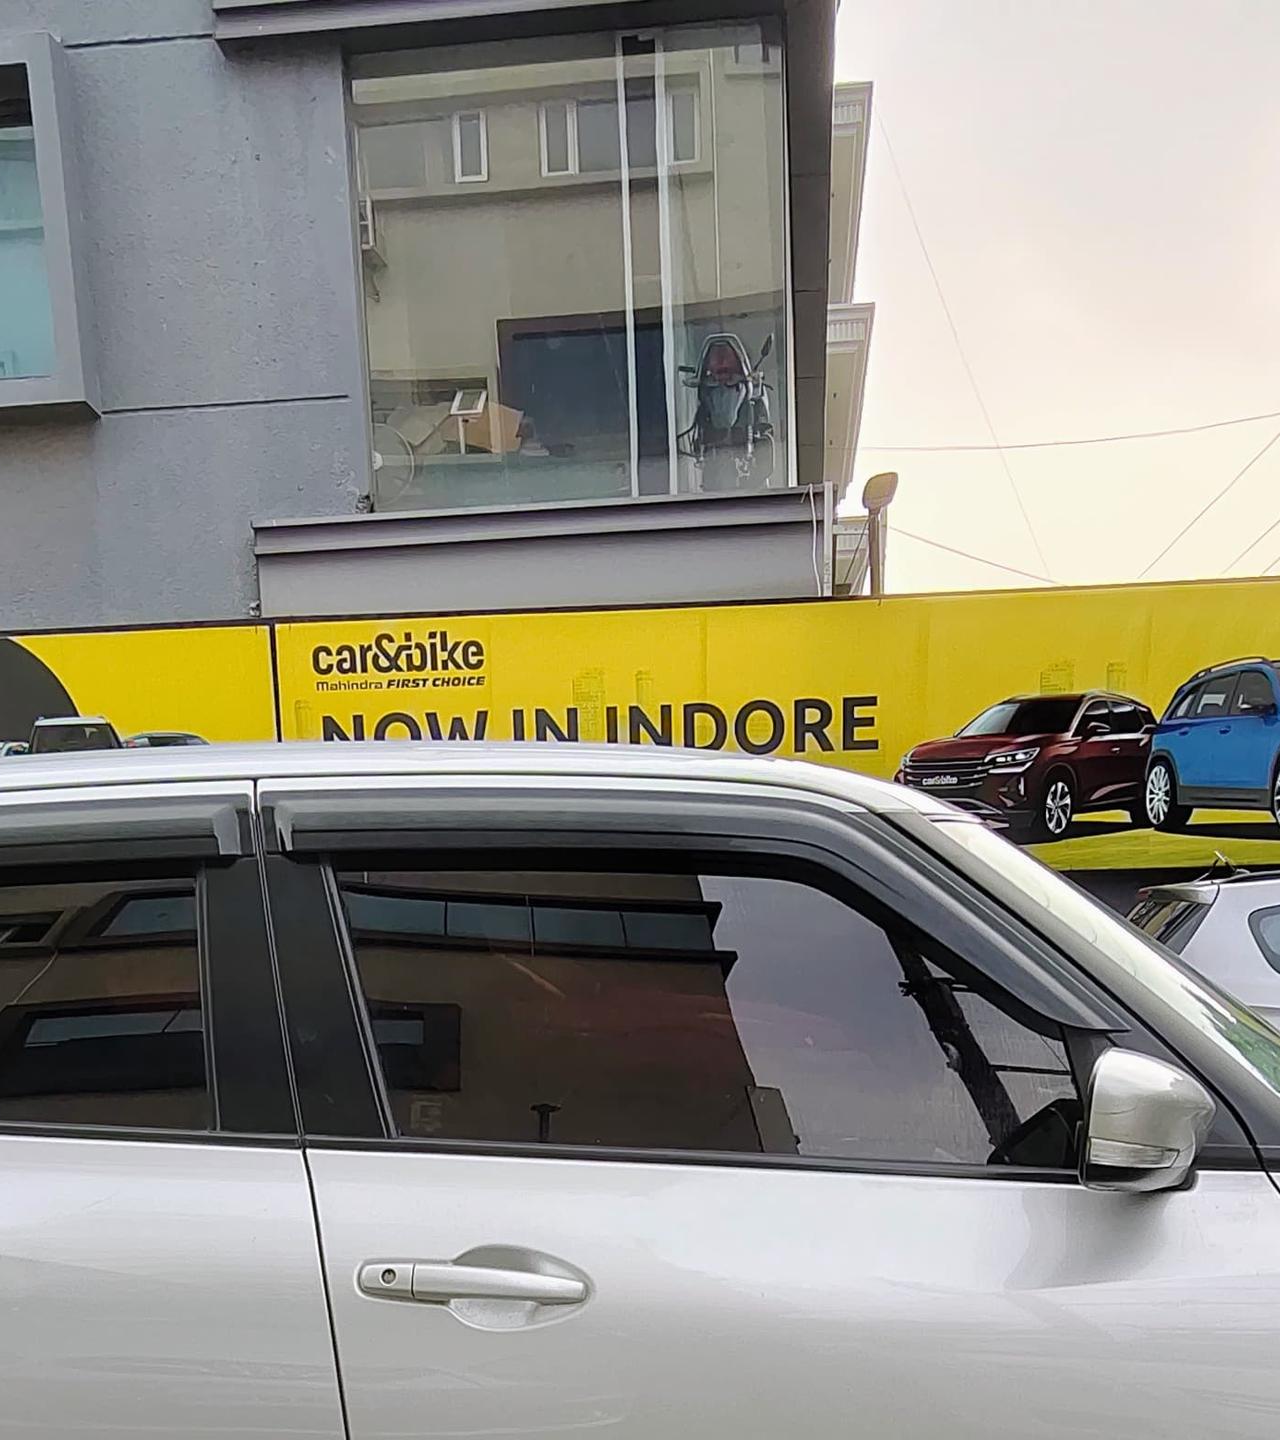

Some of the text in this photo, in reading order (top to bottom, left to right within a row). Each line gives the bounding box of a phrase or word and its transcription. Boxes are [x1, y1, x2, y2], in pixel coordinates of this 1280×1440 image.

[312, 631, 484, 675] car&bike
[316, 676, 486, 692] Mahindra FIRST CHOICE
[512, 707, 578, 742] IN
[606, 696, 880, 756] INDORE
